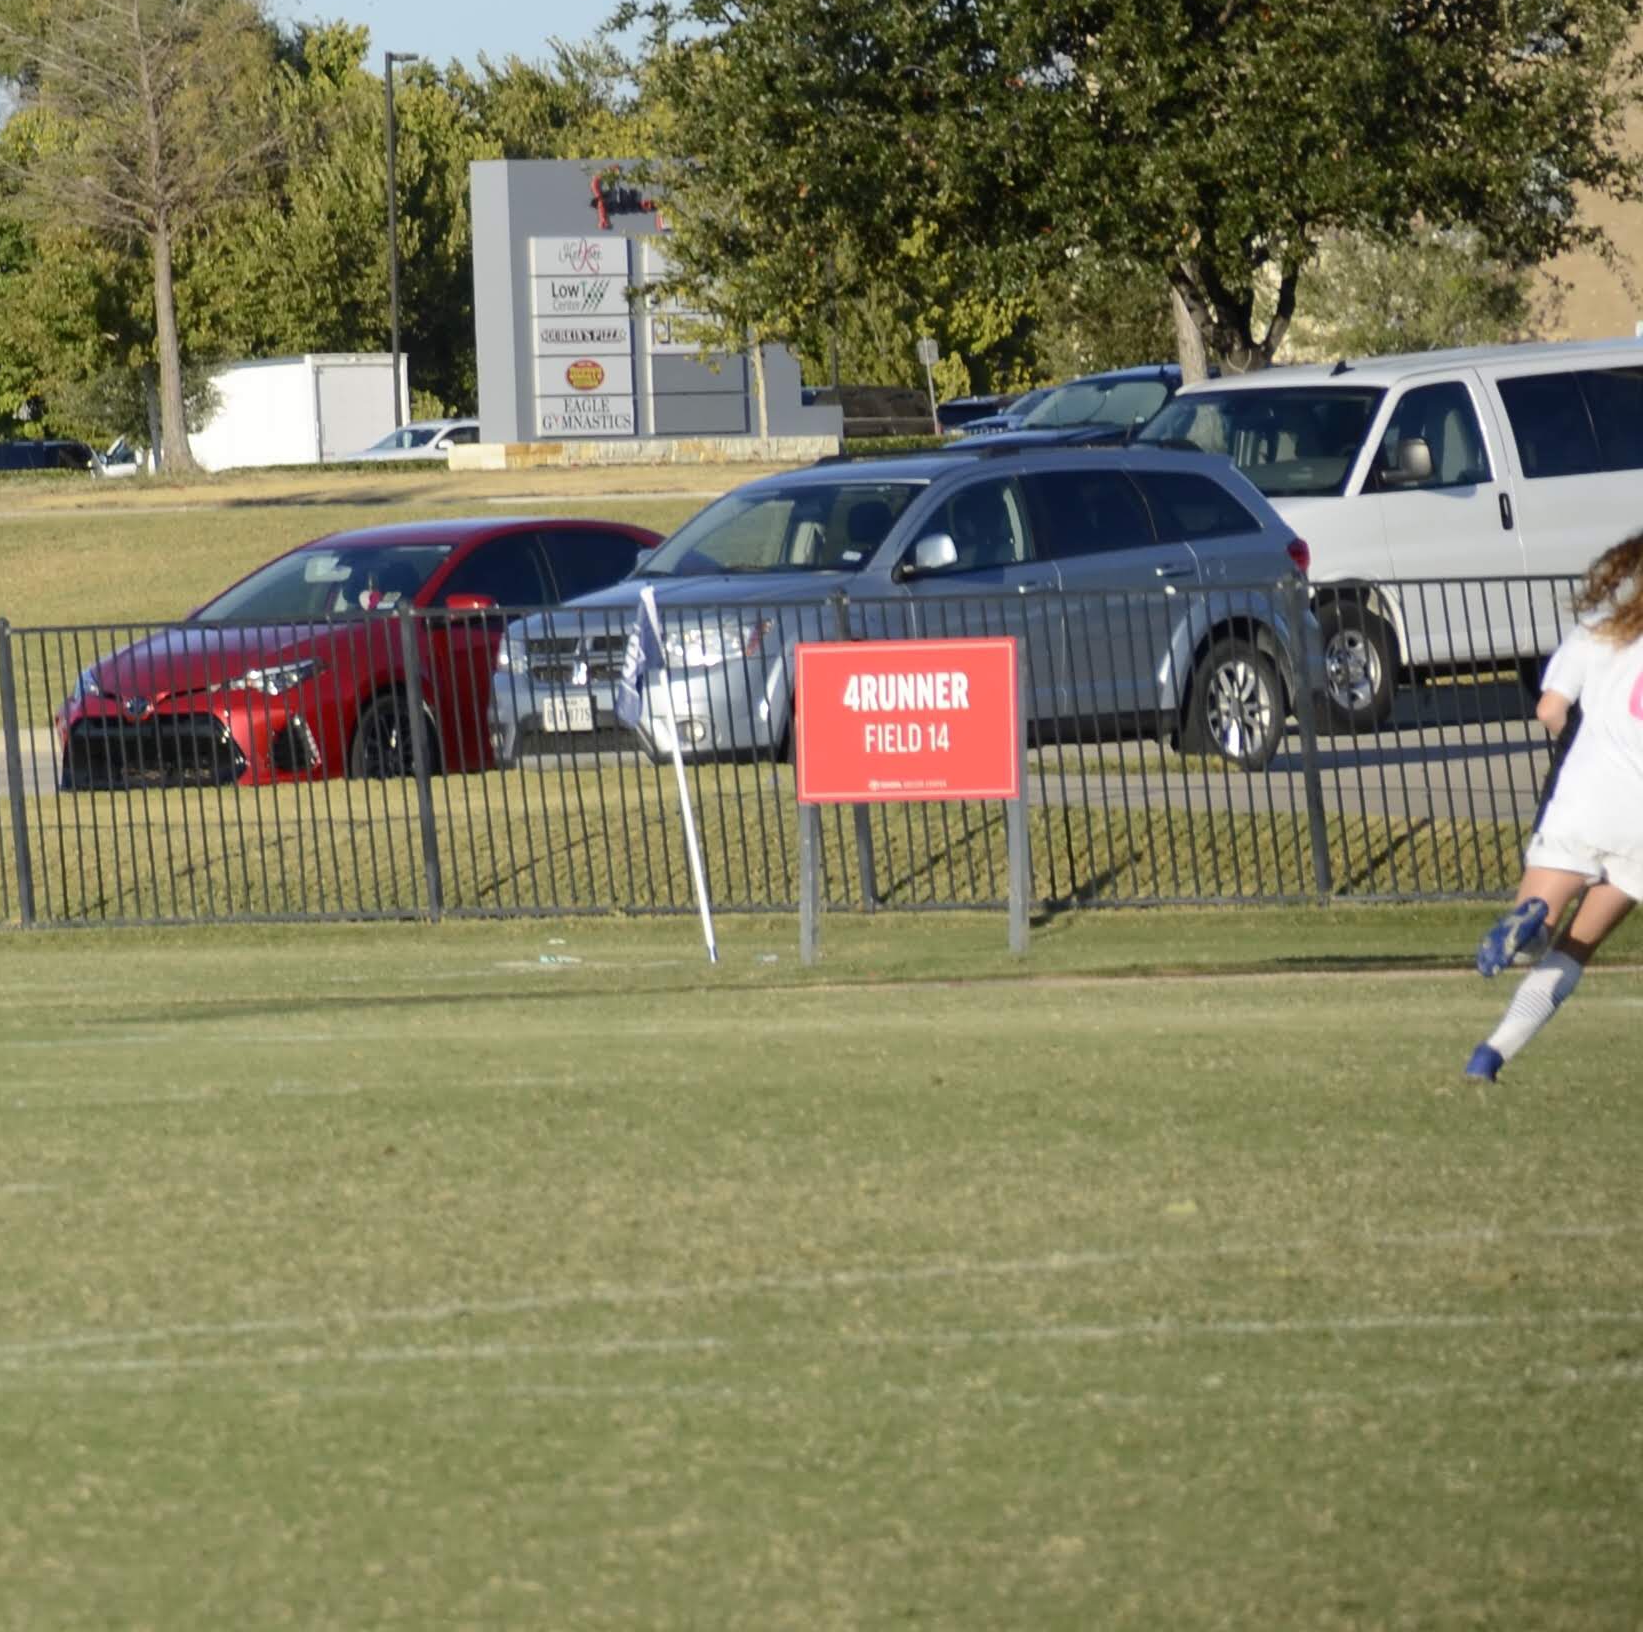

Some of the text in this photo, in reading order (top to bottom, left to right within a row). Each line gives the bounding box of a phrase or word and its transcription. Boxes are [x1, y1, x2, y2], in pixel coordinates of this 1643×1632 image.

[564, 397, 611, 414] EAGLE
[543, 414, 632, 431] GYMNASTICS
[843, 671, 970, 713] 4RUNNER
[864, 722, 950, 753] FIELD 14
